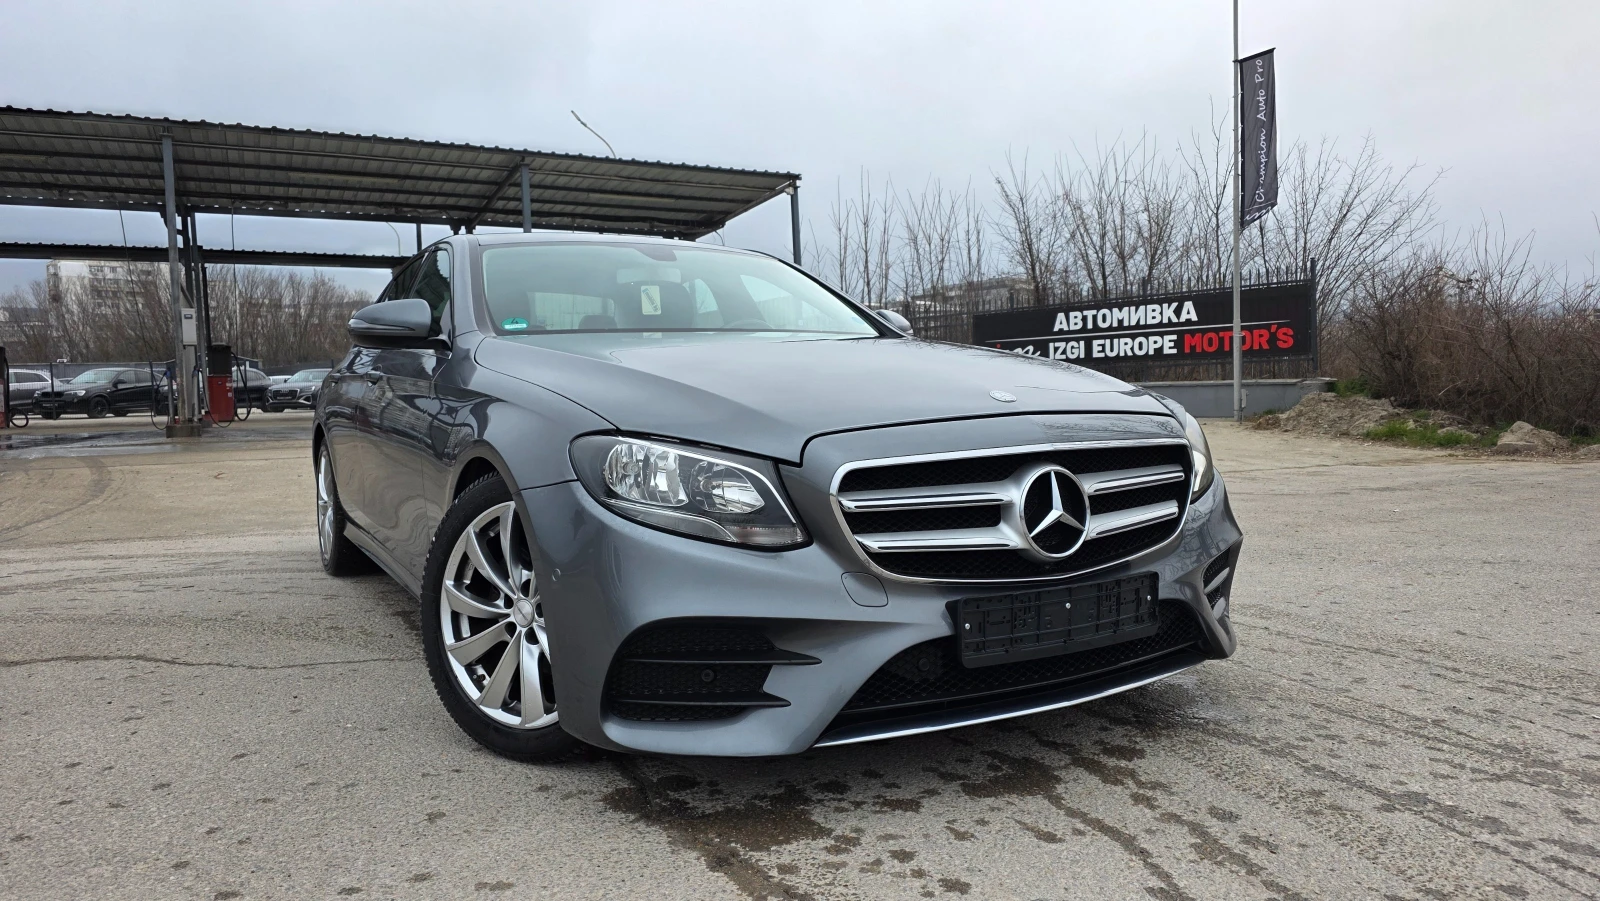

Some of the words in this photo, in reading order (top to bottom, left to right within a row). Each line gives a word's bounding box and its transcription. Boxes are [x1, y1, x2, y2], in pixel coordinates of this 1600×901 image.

[1254, 59, 1265, 84] Pro
[1257, 89, 1267, 121] Auto
[1053, 301, 1198, 332] АВТОМИВКА
[1048, 340, 1085, 360] IZGI
[1092, 334, 1178, 358] EUROPE
[1184, 324, 1294, 354] MOTOR'S
